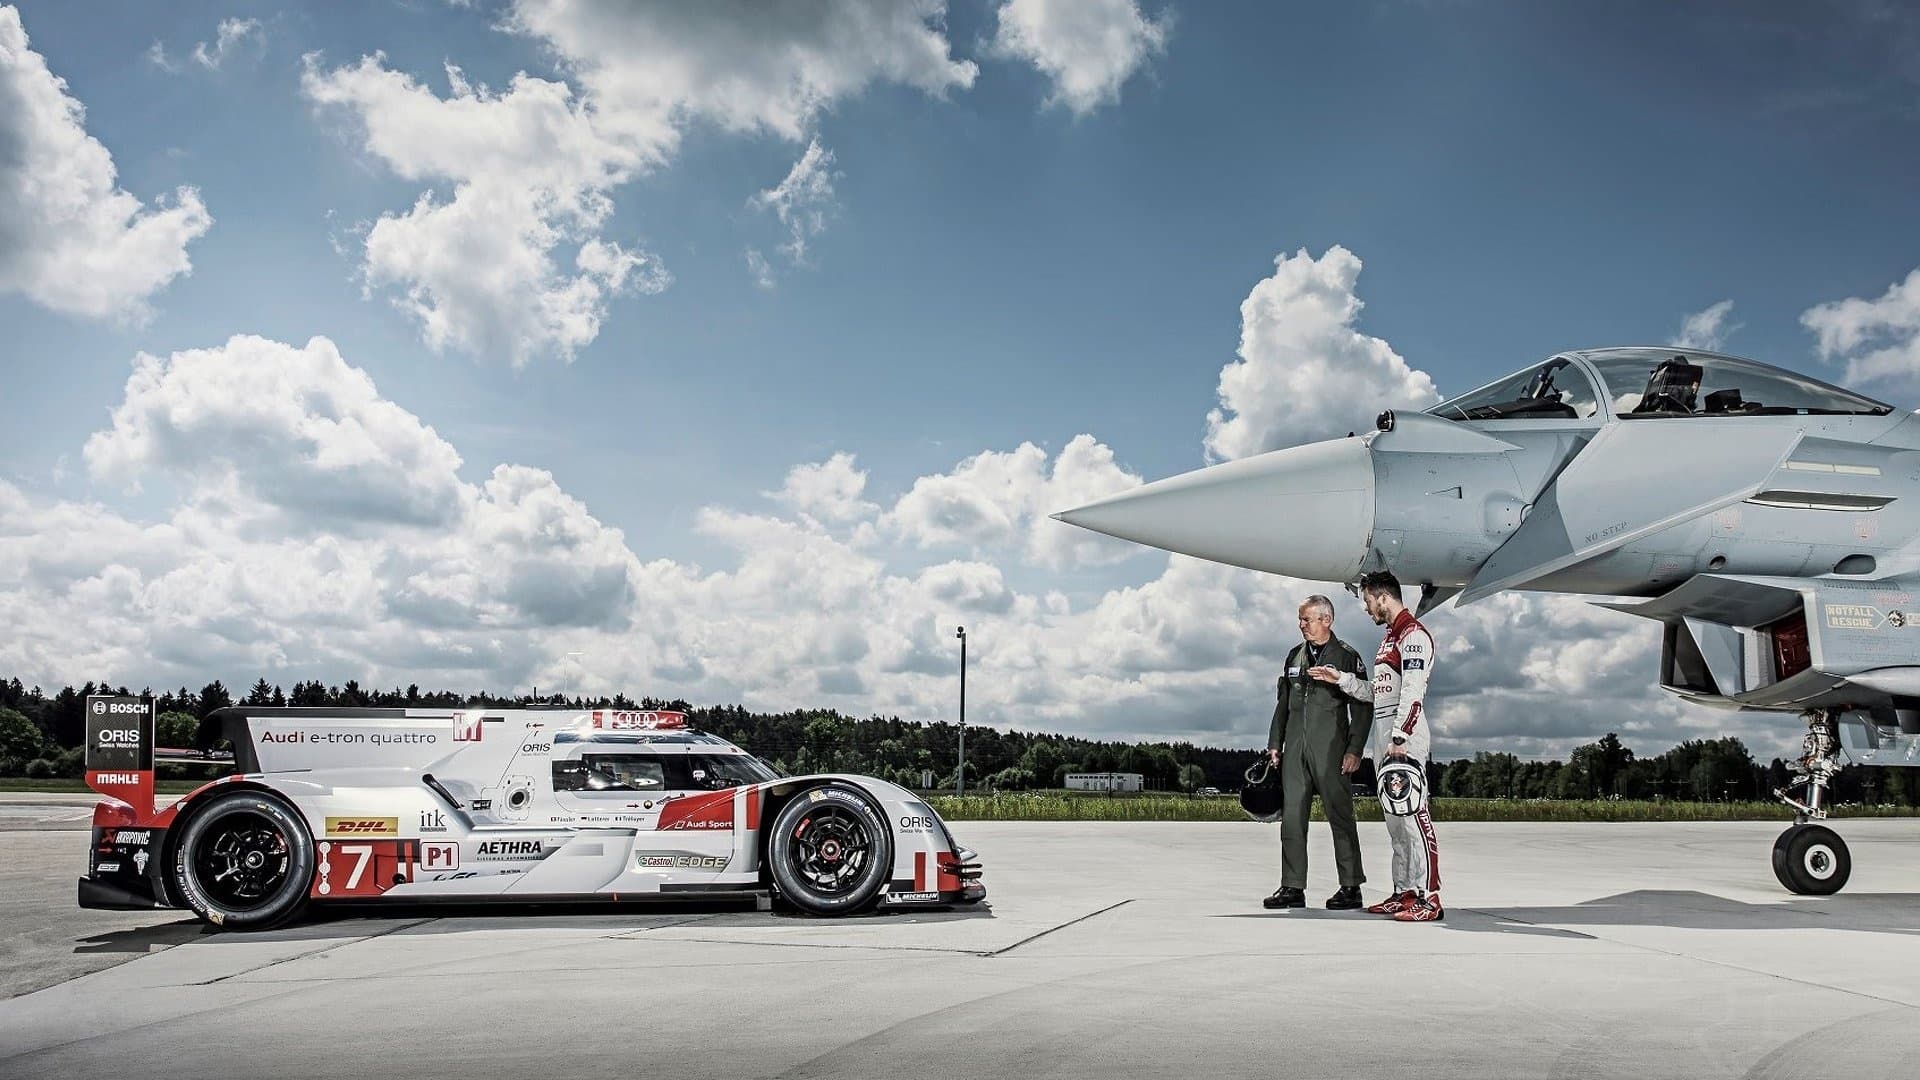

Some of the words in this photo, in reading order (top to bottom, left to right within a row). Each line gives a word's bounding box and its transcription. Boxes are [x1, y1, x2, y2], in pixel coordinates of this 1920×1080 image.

[1584, 531, 1599, 544] NO
[1601, 520, 1629, 539] STEP
[1827, 606, 1874, 617] NOTFALL
[1831, 617, 1873, 627] RESCUE
[110, 703, 149, 714] BOSCH
[99, 729, 140, 742] ORIS
[261, 731, 305, 743] Audi
[310, 732, 365, 743] e-tron
[370, 732, 436, 746] quattro
[522, 742, 551, 752] ORIS
[97, 773, 139, 784] MAHLE
[827, 790, 864, 806] MICHELIN
[420, 809, 445, 827] itk
[900, 816, 933, 828] ORIS
[336, 821, 387, 833] DHL
[686, 820, 706, 828] Audi
[708, 820, 733, 829] Sport
[477, 841, 542, 854] AETHRA
[427, 847, 452, 866] P1
[647, 857, 673, 867] Castrol
[677, 856, 727, 867] EDGE
[341, 845, 373, 889] 7
[901, 892, 938, 900] MICHELIN
